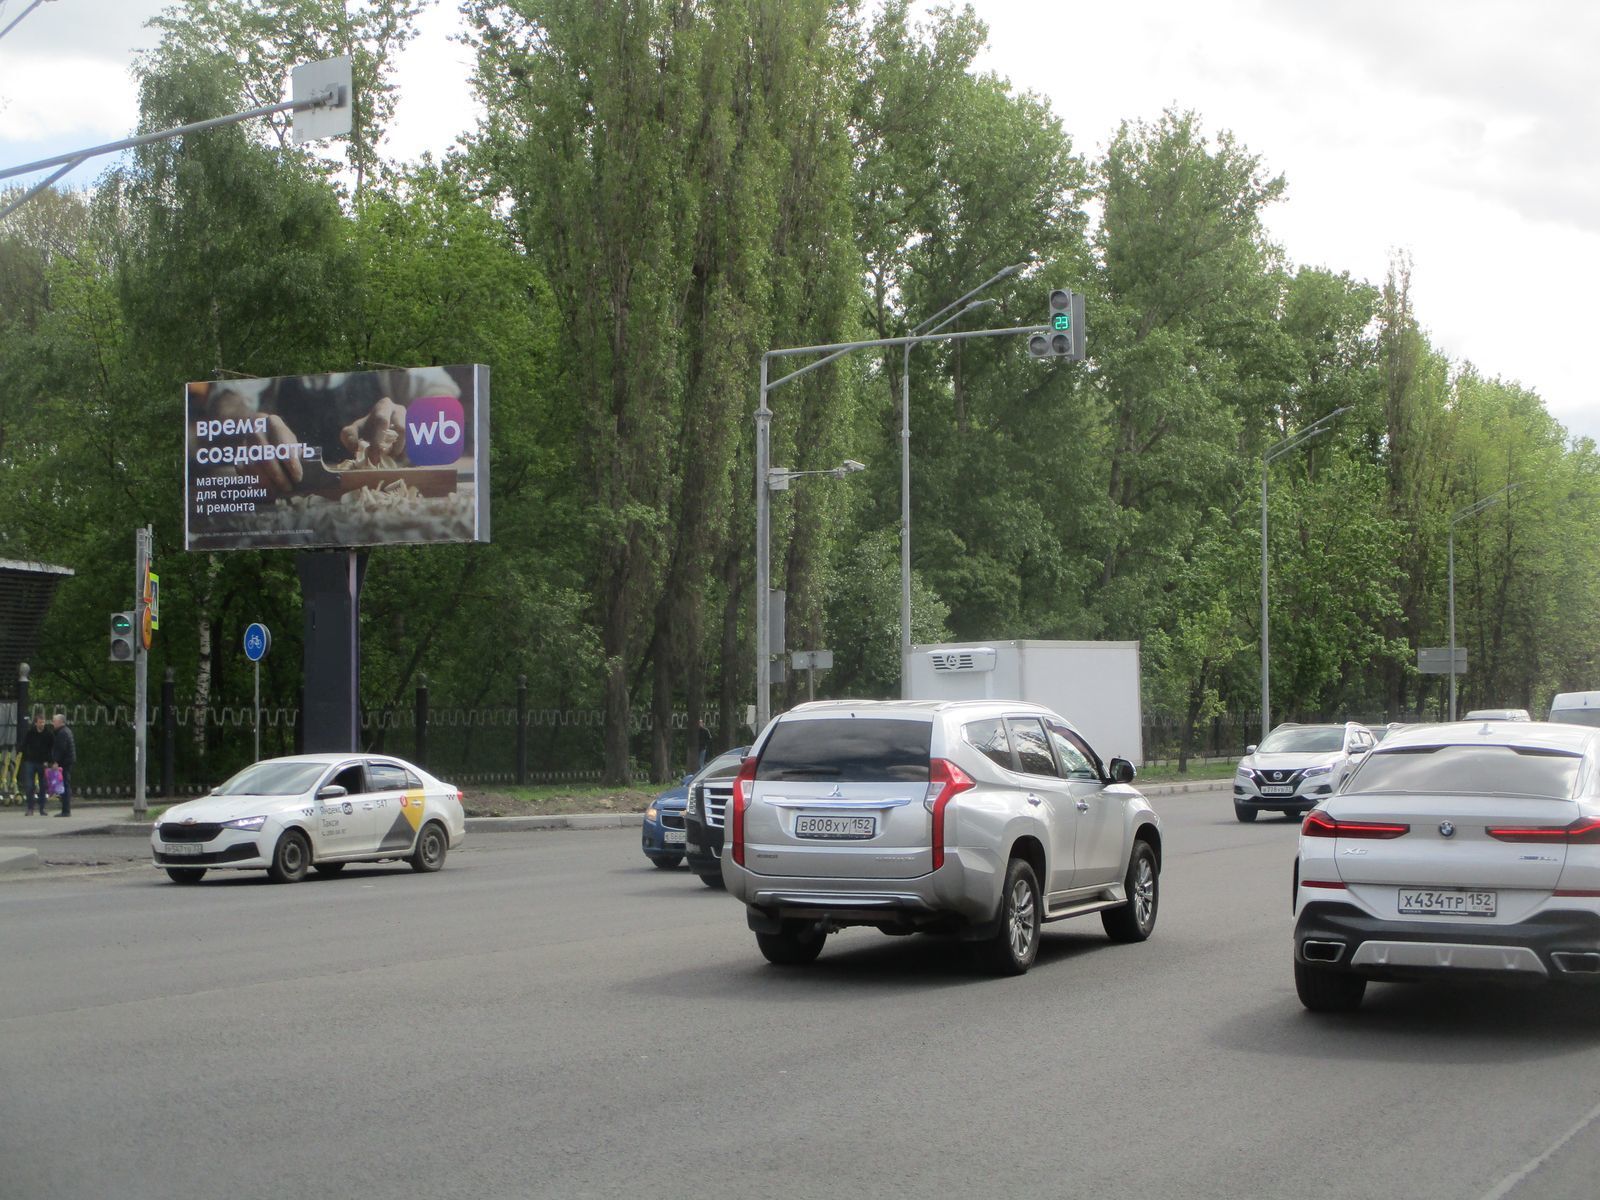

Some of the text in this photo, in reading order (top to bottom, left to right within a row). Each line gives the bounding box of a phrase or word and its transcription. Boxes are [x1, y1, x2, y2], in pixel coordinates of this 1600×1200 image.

[1055, 316, 1069, 330] 23
[196, 415, 267, 441] время
[408, 411, 461, 446] wb
[196, 443, 315, 466] создавать
[196, 474, 260, 487] материалы
[196, 487, 267, 501] для стройки
[196, 502, 256, 515] и ремонта
[321, 819, 340, 828] Такси
[852, 819, 870, 830] 152
[1468, 893, 1491, 906] 152
